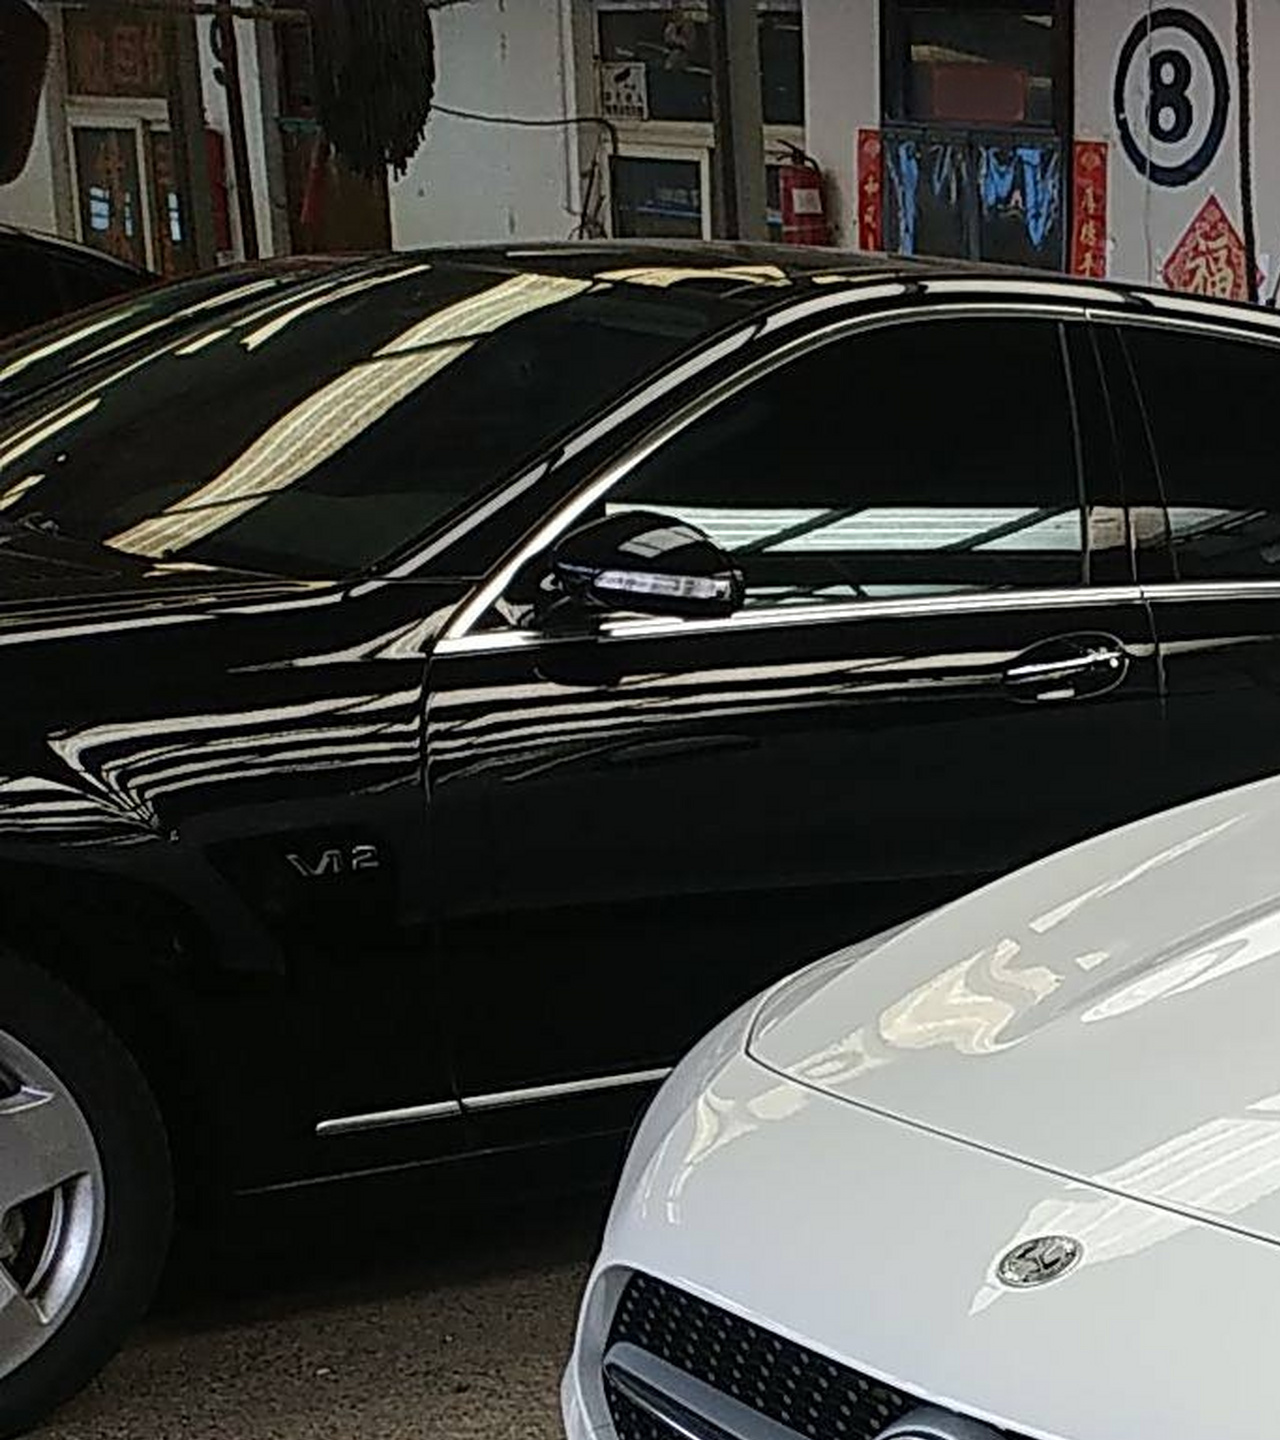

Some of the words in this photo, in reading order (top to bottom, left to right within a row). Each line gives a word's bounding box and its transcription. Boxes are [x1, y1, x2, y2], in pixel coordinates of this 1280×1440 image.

[1147, 49, 1194, 143] 8
[1186, 231, 1235, 297] 福
[285, 844, 380, 876] V12
